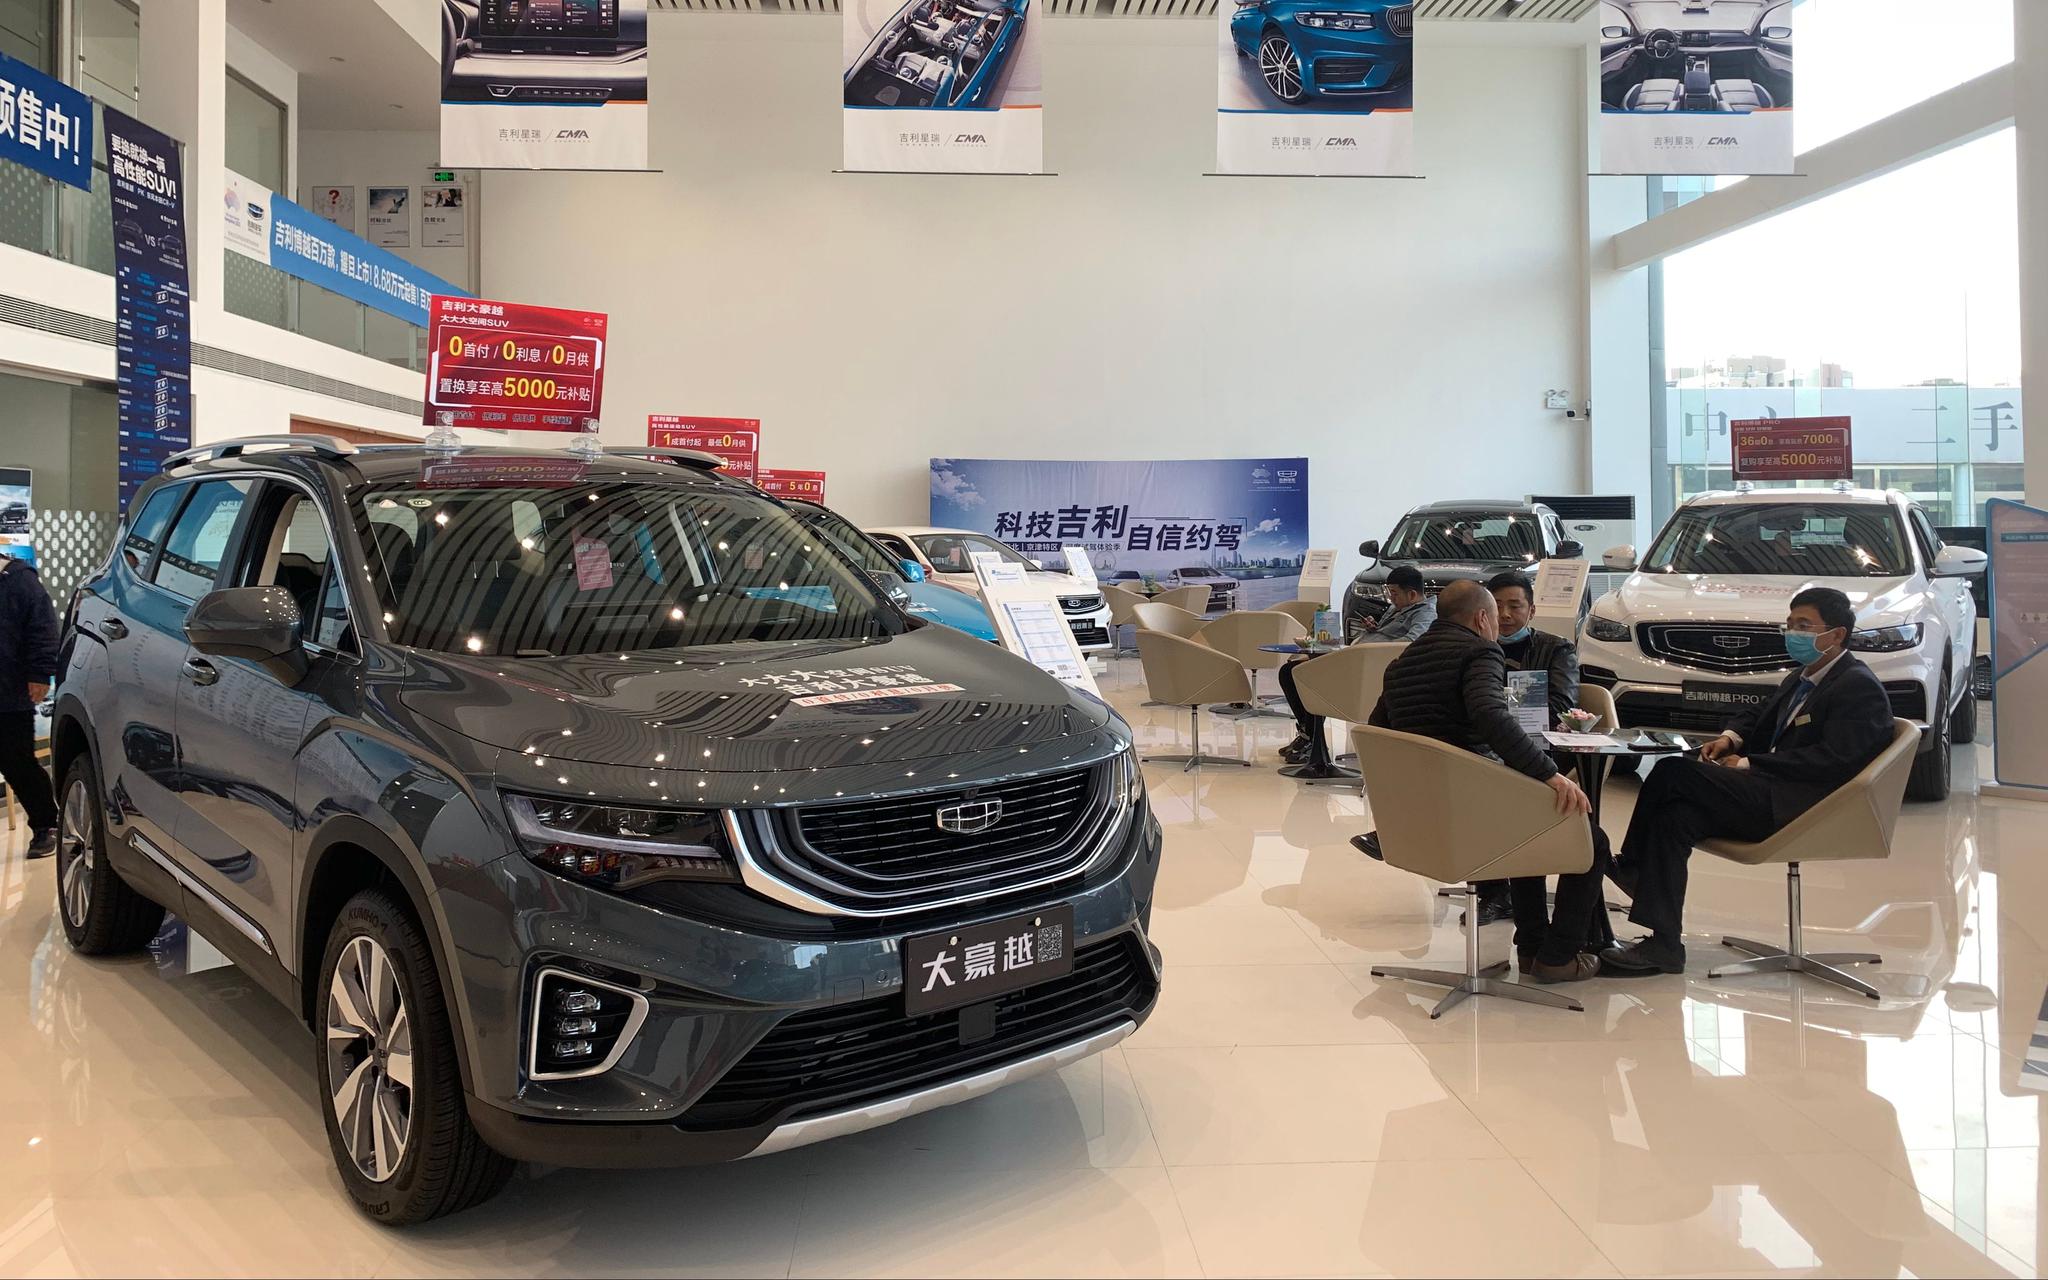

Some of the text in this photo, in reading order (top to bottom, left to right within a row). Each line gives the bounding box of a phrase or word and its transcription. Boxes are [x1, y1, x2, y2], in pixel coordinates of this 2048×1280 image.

[499, 128, 541, 138] 吉利星瑞
[556, 130, 589, 138] CMA
[899, 133, 940, 143] 吉利星瑞
[954, 134, 986, 143] CMA
[1325, 137, 1357, 146] CMA
[1707, 137, 1738, 145] CMA
[112, 154, 177, 200] 高性能SUV!
[144, 233, 156, 247] VS
[441, 300, 504, 316] 吉利大豪越
[440, 314, 510, 328] 大大大空间SUV
[439, 377, 591, 401] 置换享至高5000元补贴
[994, 504, 1128, 539] 科技吉利
[1127, 524, 1243, 551] 自信约驾
[1026, 543, 1058, 551] 京津特区
[775, 672, 935, 696] 吉利大豪越
[921, 932, 1034, 993] 大豪越
